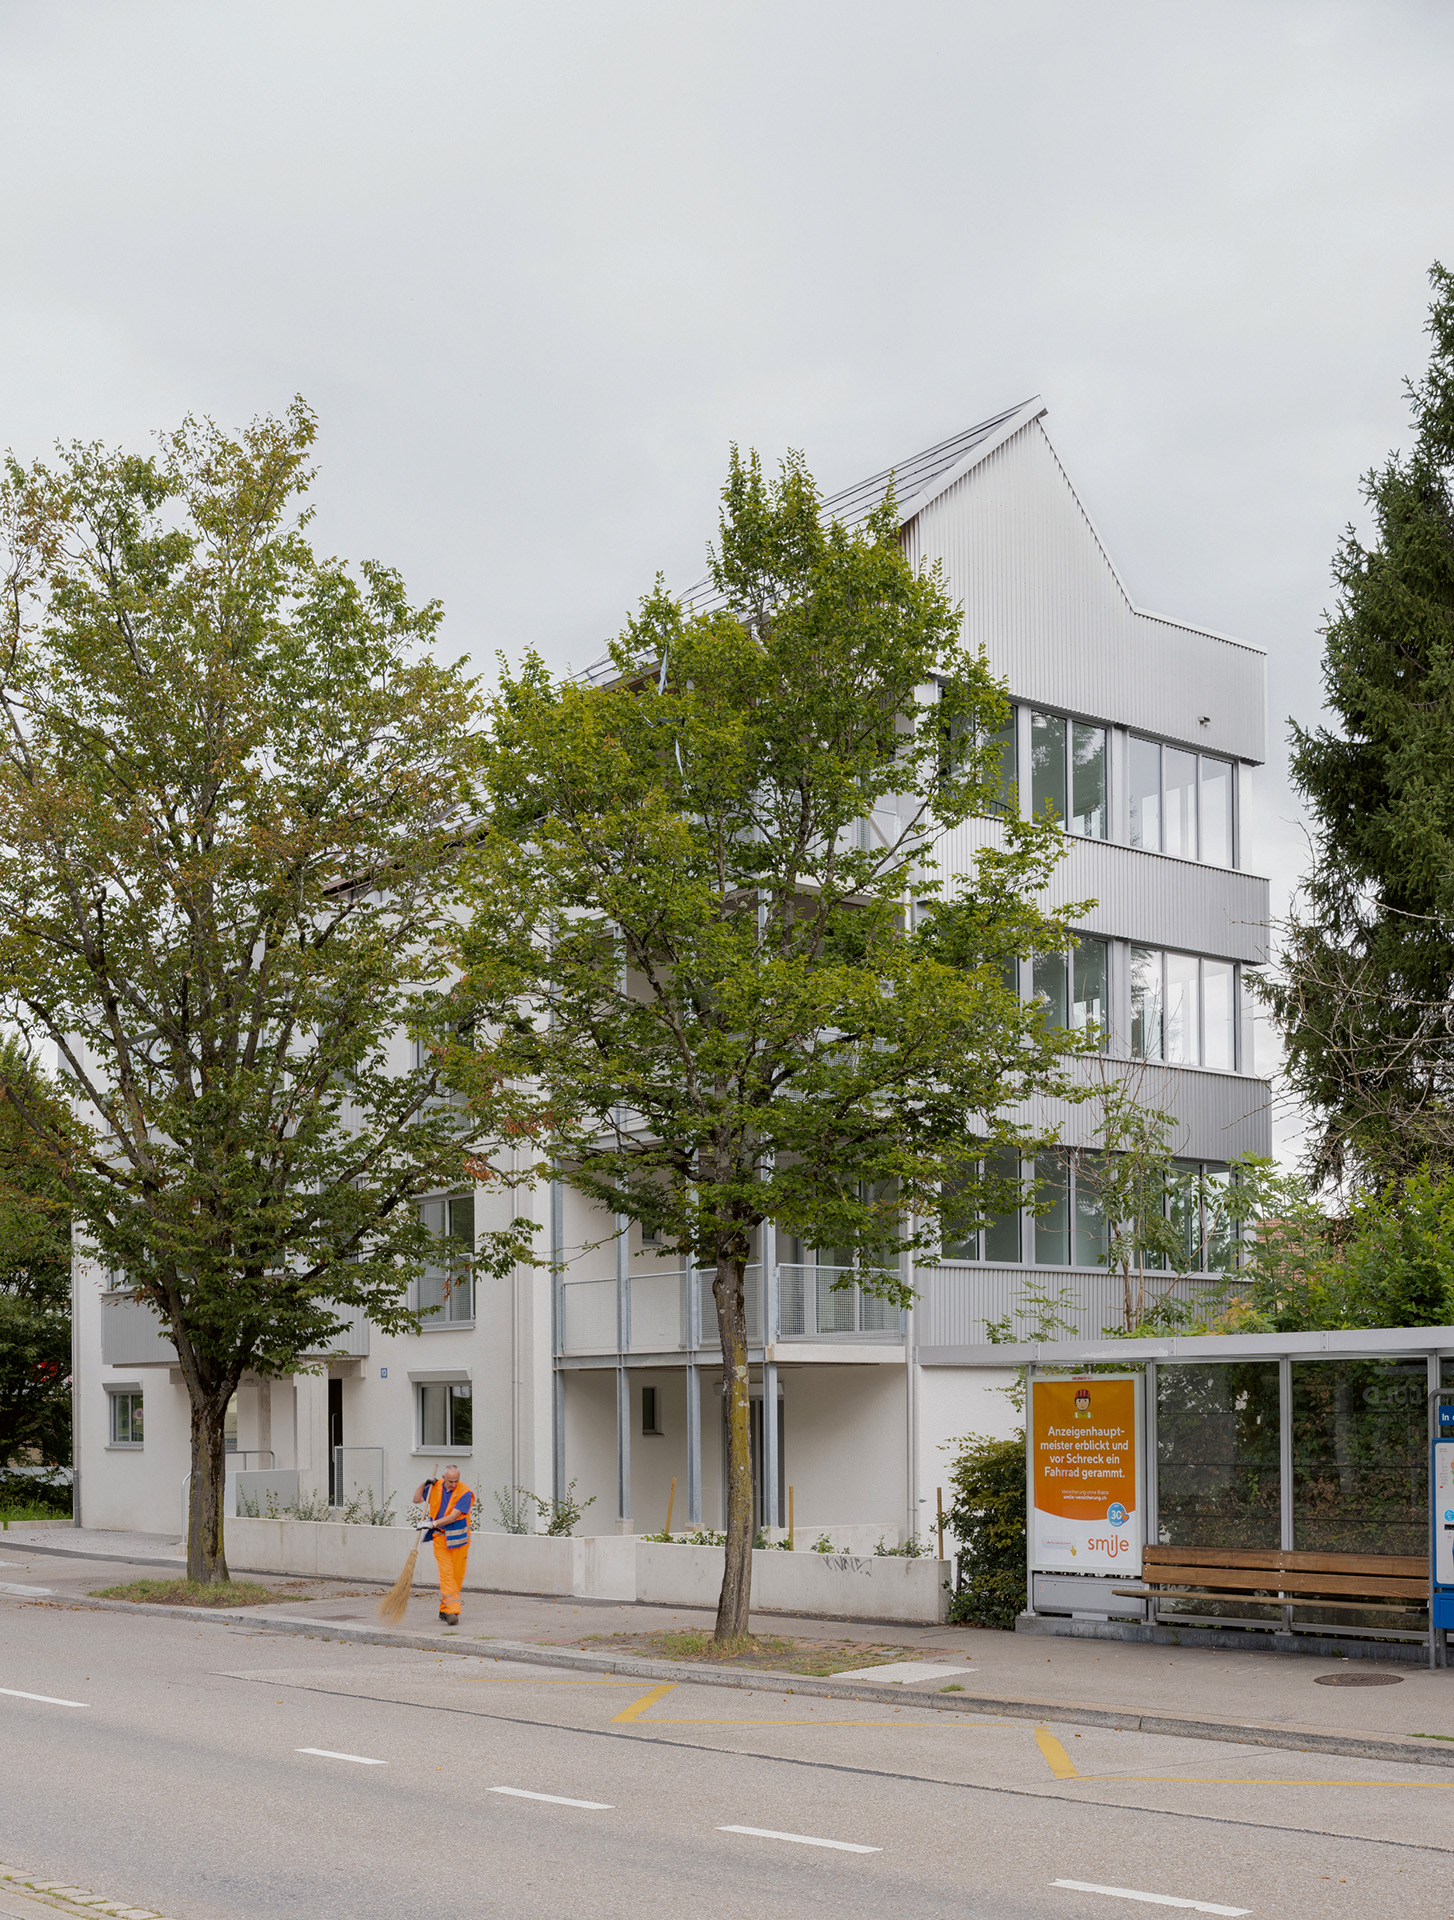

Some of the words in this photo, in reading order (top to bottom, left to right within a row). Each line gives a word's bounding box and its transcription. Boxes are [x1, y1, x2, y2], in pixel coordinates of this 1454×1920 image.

[1441, 1413, 1450, 1421] In
[1048, 1426, 1125, 1439] Anzeigenhaupt-
[1040, 1440, 1073, 1450] meister
[1075, 1440, 1110, 1450] erblickt
[1112, 1440, 1129, 1450] und
[1049, 1455, 1064, 1463] vor
[1066, 1453, 1104, 1463] Schreck
[1106, 1454, 1120, 1463] ein
[1044, 1466, 1080, 1477] Fahrrad
[1081, 1468, 1125, 1480] gerammt.
[1111, 1510, 1122, 1520] 30
[1088, 1534, 1129, 1558] smile
